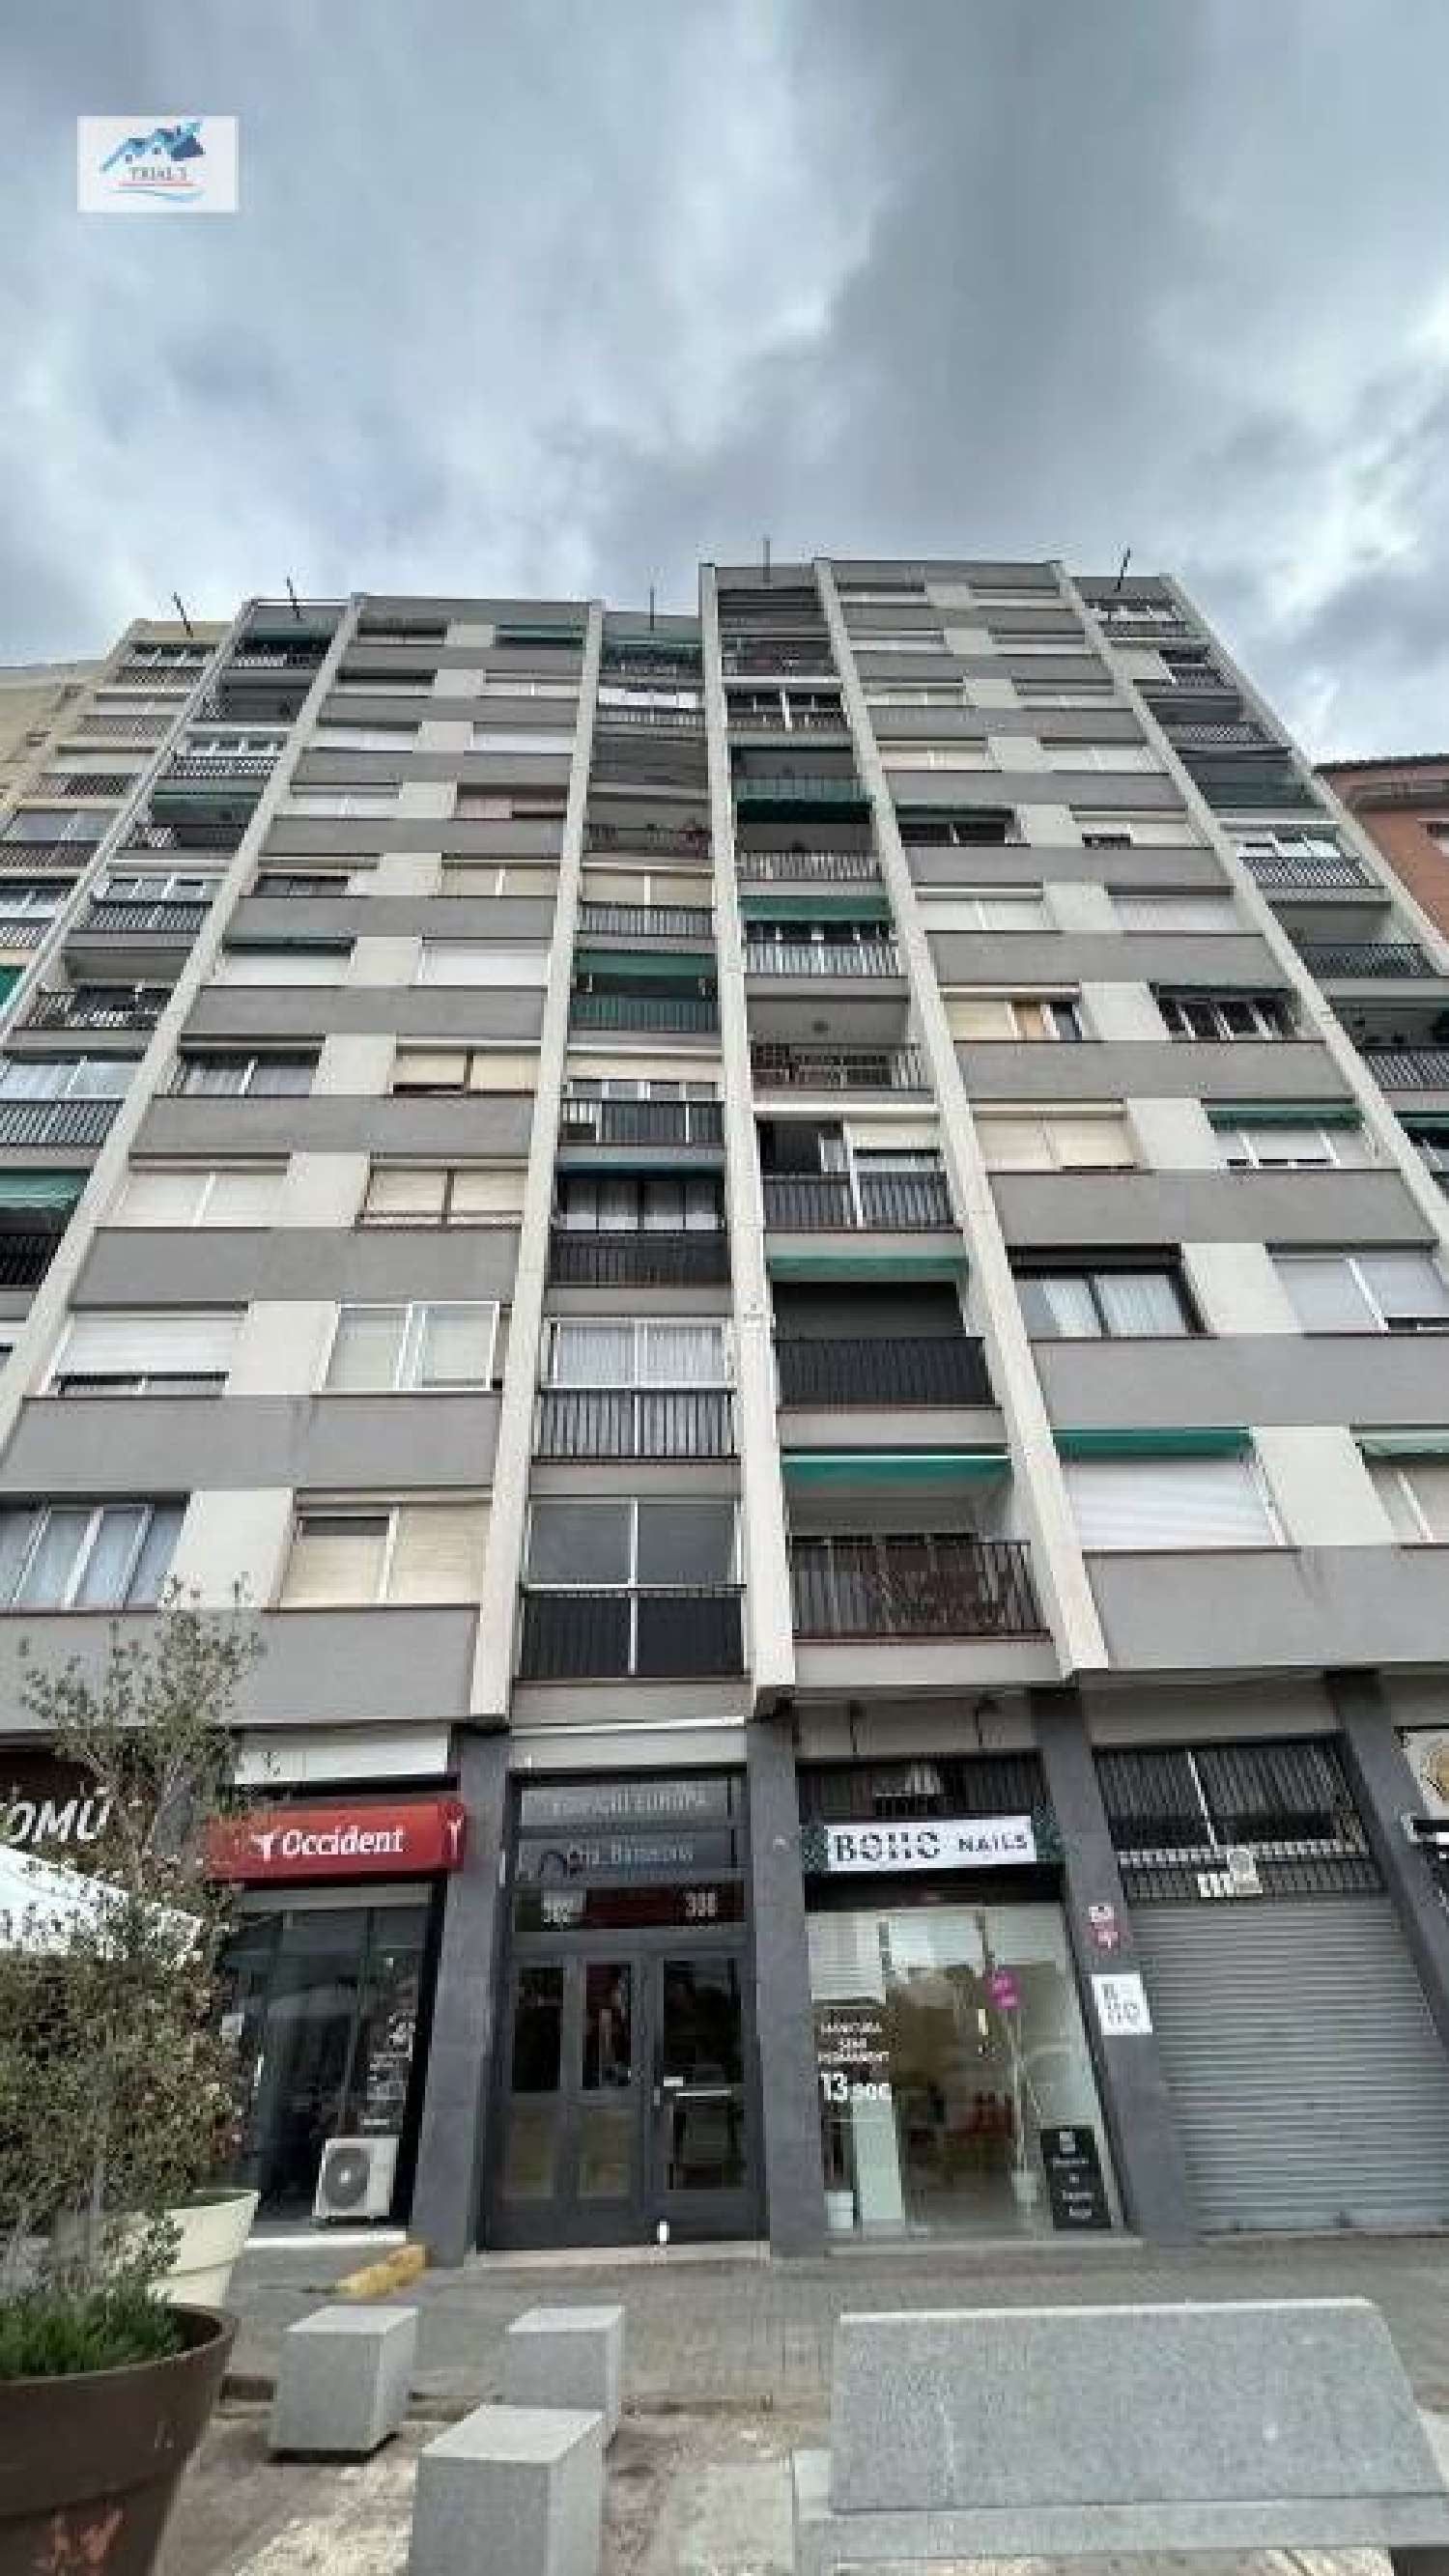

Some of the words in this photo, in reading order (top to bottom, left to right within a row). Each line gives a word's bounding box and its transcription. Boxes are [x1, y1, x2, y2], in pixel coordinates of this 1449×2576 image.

[280, 1825, 405, 1856] Occident
[834, 1831, 941, 1863] BOHO
[958, 1834, 1030, 1854] NAILS
